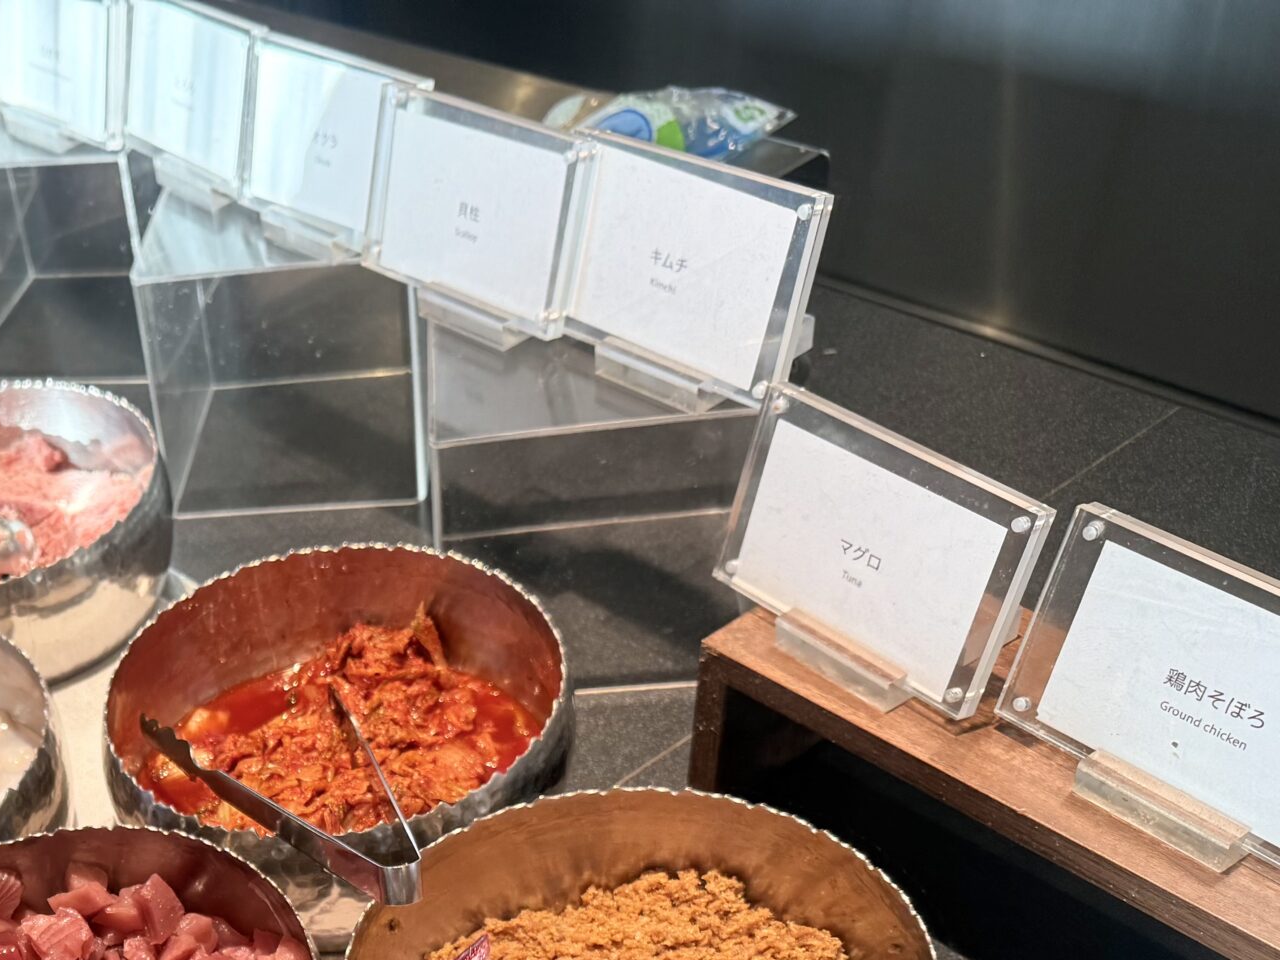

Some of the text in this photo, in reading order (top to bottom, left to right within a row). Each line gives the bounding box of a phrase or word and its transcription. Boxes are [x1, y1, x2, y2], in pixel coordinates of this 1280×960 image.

[649, 247, 688, 273] キムチ
[840, 538, 882, 571] マグロ
[842, 569, 863, 588] Tuna
[1163, 668, 1265, 729] 鶏肉そぼろ
[1160, 700, 1248, 751] Ground chicken
